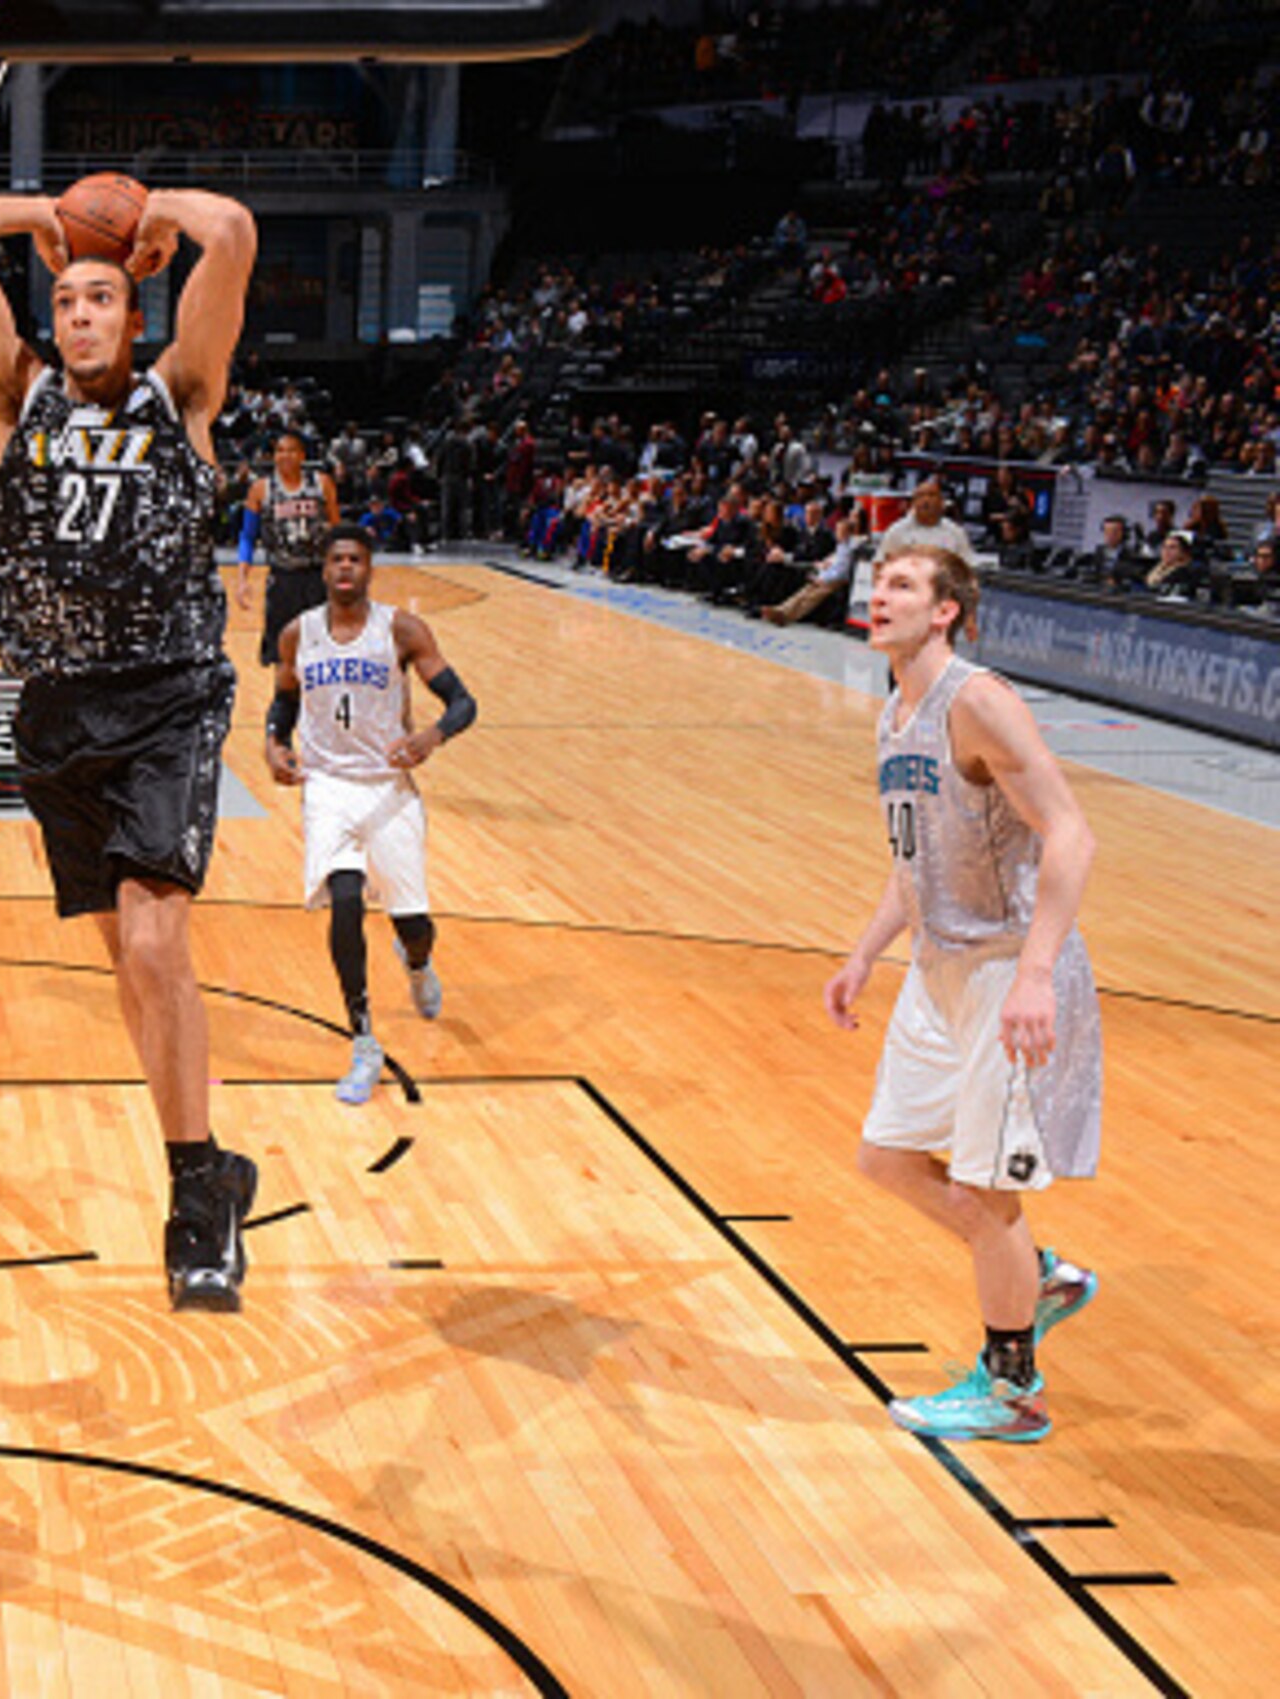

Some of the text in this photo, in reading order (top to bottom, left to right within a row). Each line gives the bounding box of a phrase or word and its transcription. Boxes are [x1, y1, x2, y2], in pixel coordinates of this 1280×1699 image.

[28, 406, 156, 471] JAZZ
[55, 473, 122, 542] 27
[304, 657, 390, 691] SIXERS
[334, 693, 351, 732] 4
